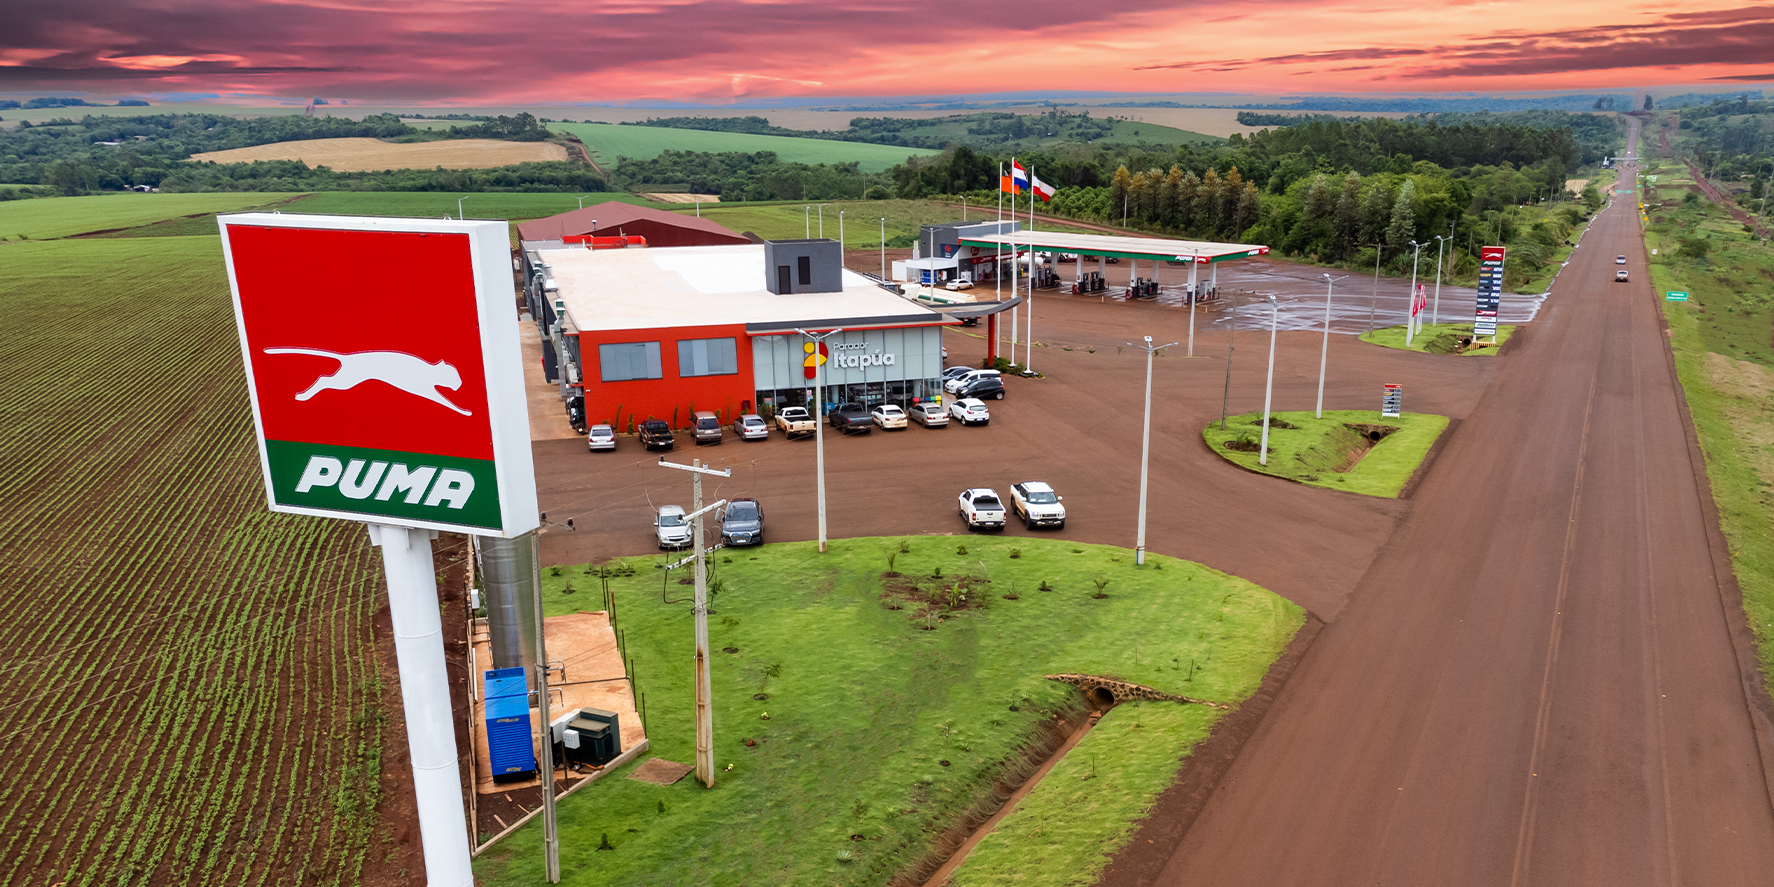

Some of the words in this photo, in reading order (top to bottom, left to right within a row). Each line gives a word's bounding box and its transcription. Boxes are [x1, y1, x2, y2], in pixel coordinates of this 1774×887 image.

[834, 342, 868, 350] Parador
[834, 350, 895, 371] Itapúa
[295, 454, 475, 510] PUMA
